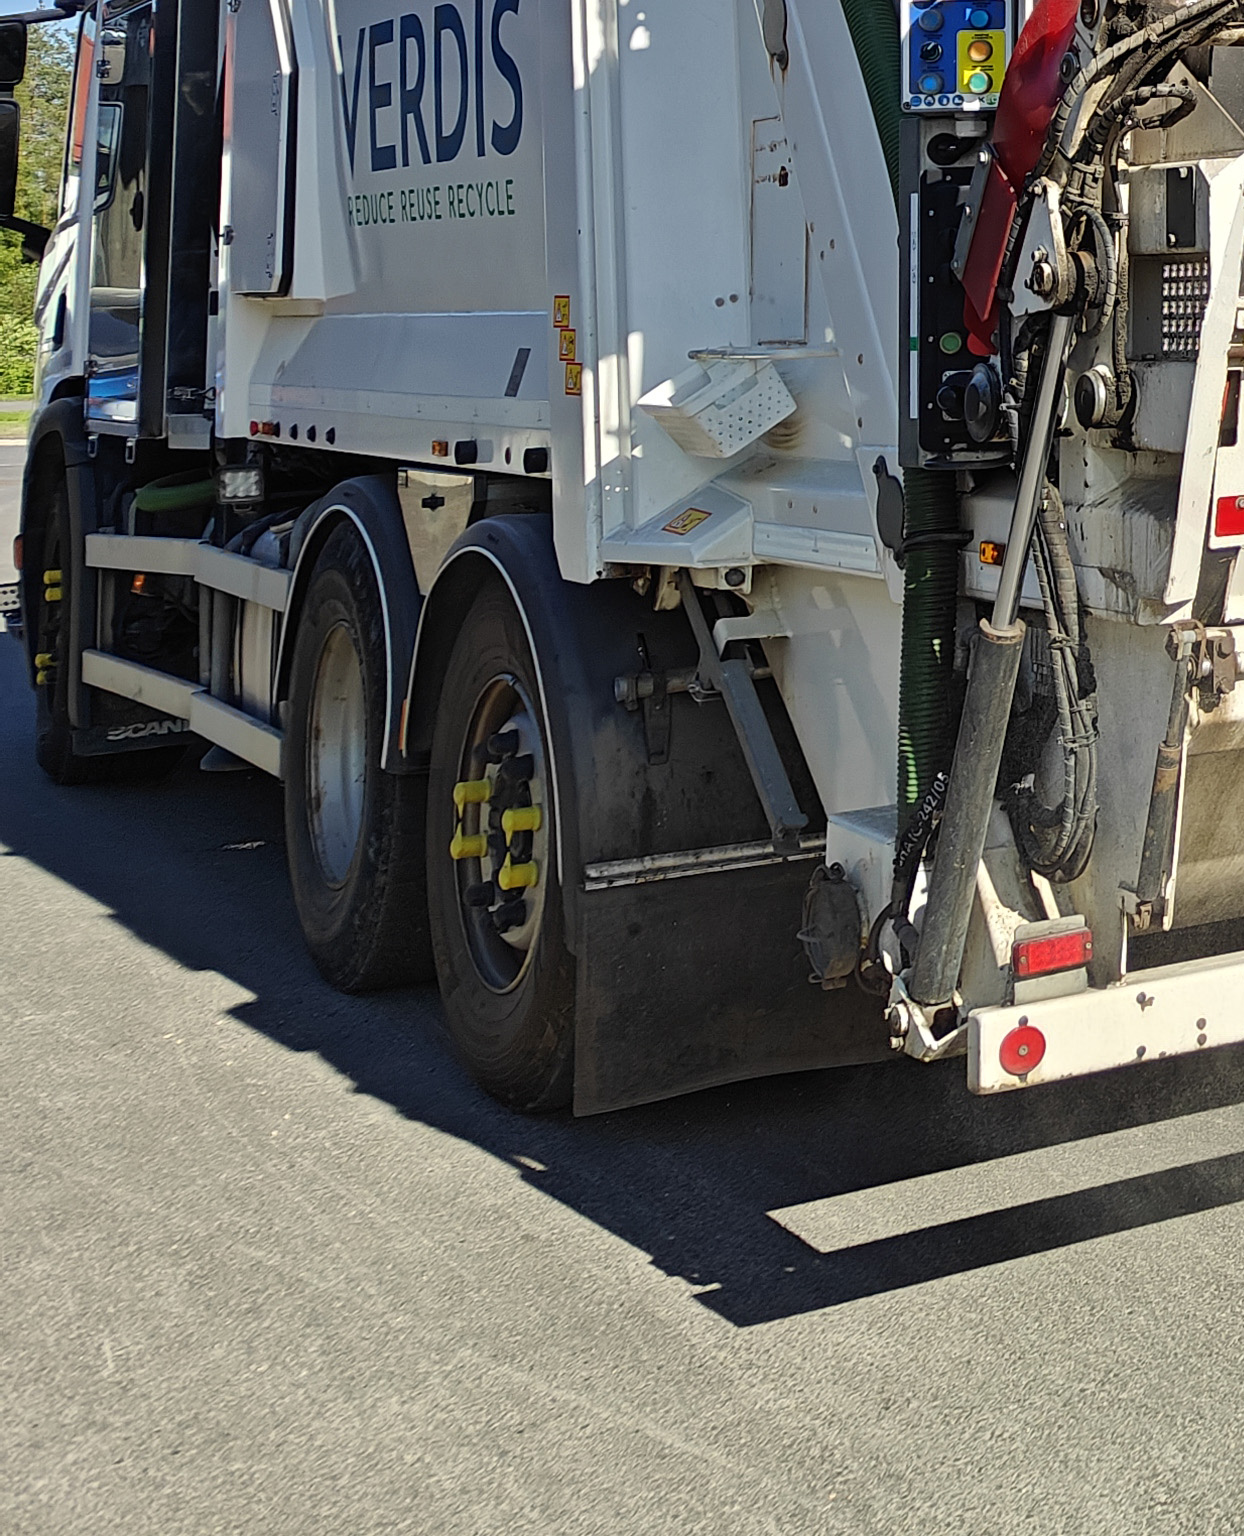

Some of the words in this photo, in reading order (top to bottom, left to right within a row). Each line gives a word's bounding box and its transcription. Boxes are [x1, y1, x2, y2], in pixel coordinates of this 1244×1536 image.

[347, 191, 396, 227] REDUCE
[400, 186, 442, 223] REUSE
[448, 179, 516, 219] RECYCLE
